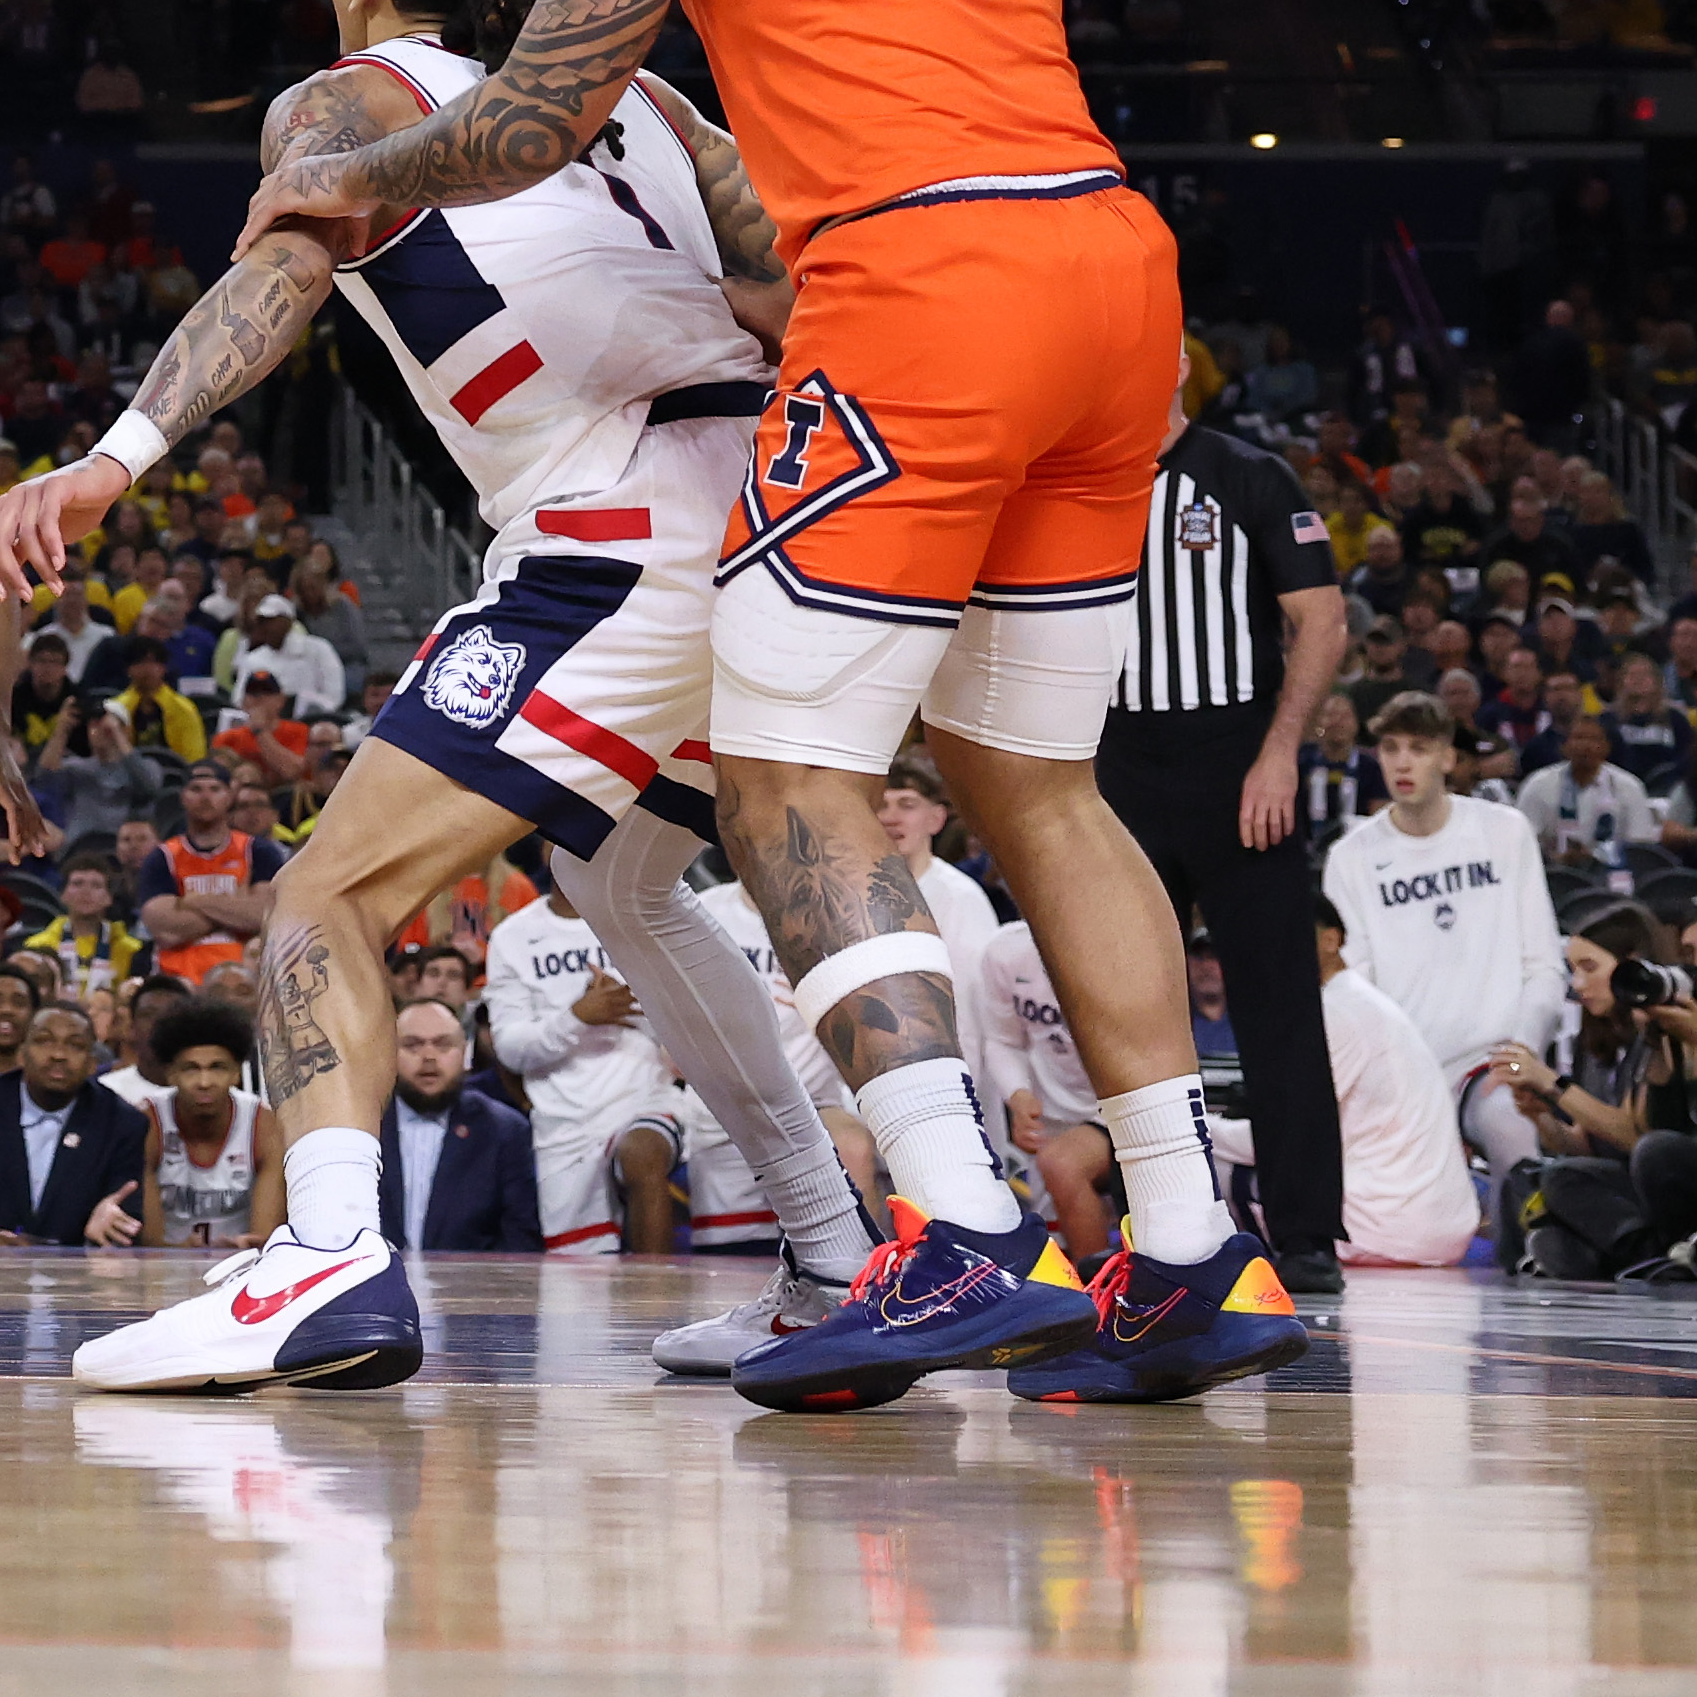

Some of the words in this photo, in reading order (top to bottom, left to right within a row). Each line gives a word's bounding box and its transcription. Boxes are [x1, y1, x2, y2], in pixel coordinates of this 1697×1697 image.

[1379, 873, 1442, 907] LOCK
[1444, 866, 1463, 894] IT
[532, 947, 590, 980] LOCK
